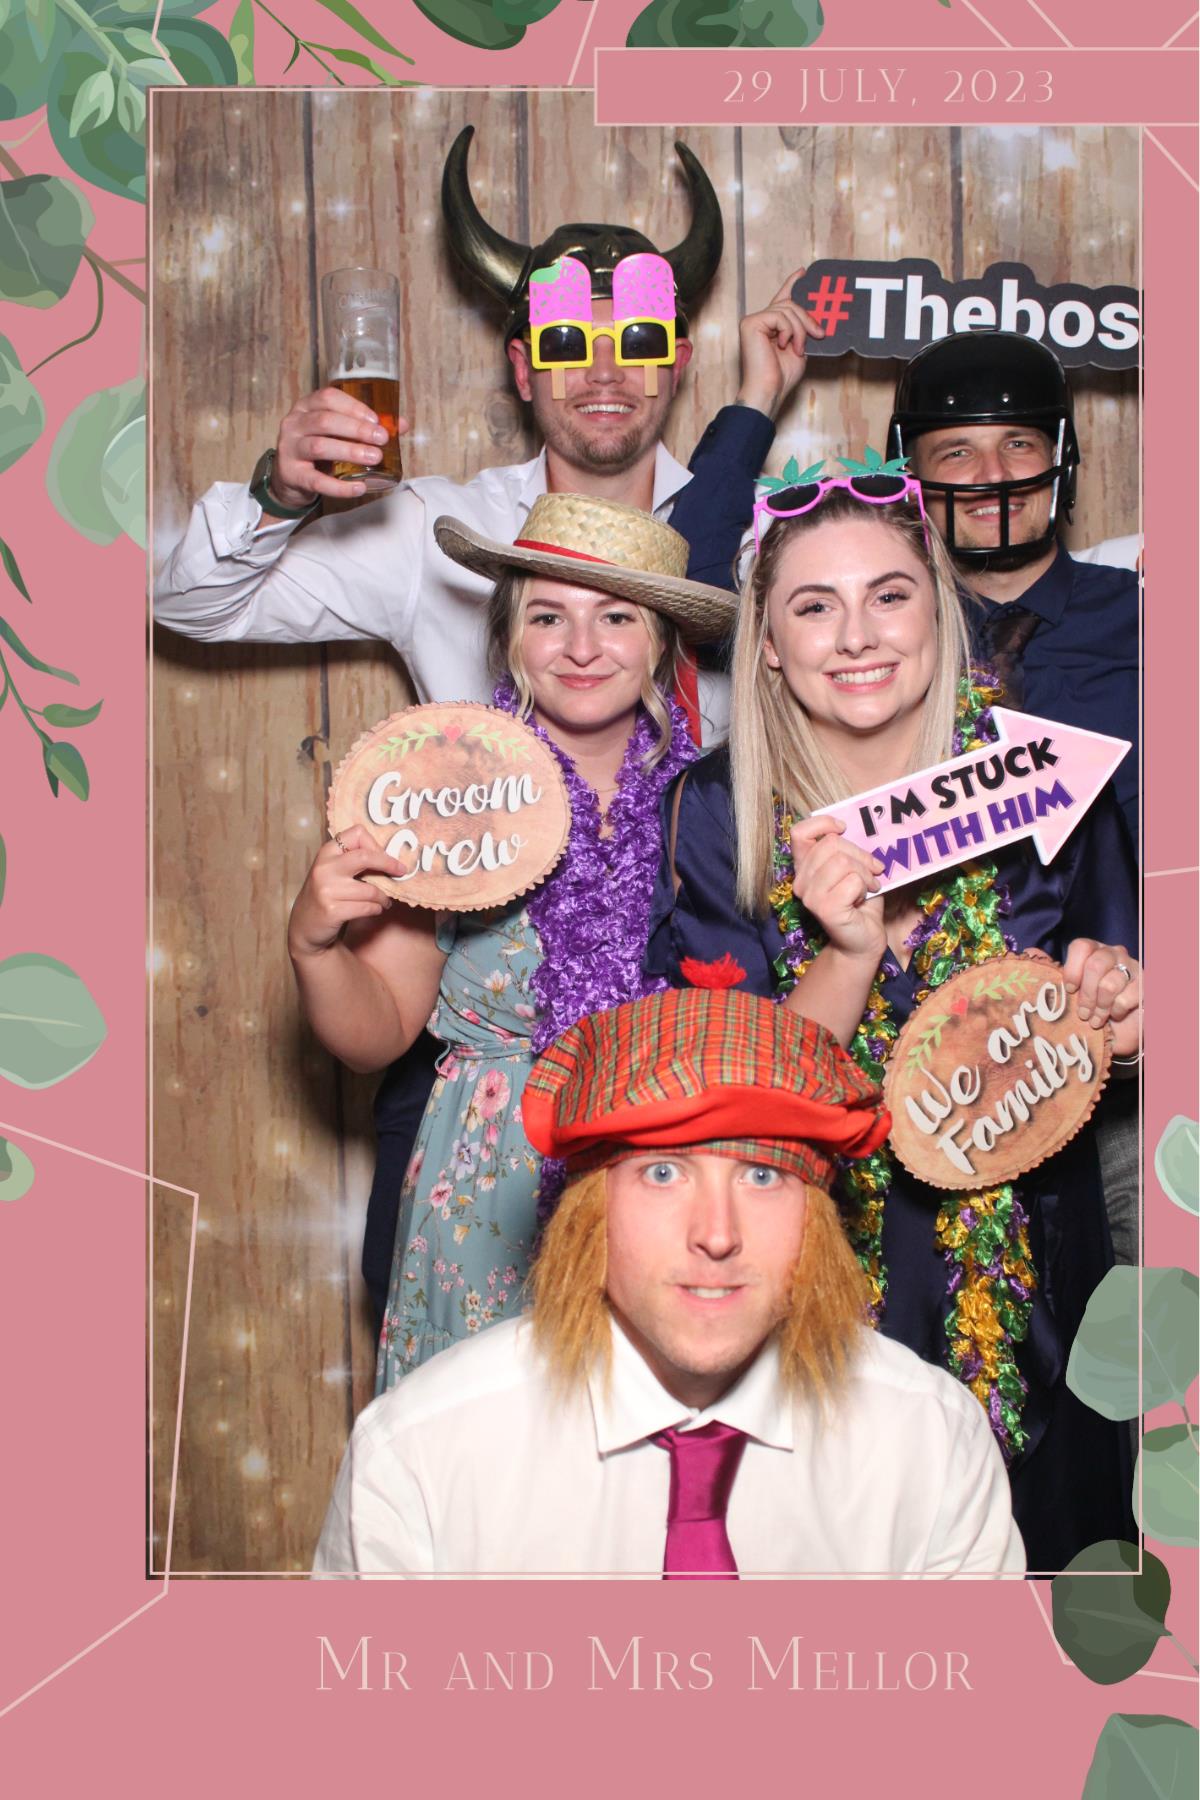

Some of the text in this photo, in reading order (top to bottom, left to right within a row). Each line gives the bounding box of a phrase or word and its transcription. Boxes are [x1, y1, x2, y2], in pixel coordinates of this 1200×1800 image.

[807, 275, 1144, 350] #Thebos
[367, 770, 542, 826] Groom
[859, 737, 1061, 838] I'M STUCK
[871, 779, 1076, 880] WITH HIM
[385, 829, 528, 882] Crew
[904, 980, 1067, 1135] We are
[936, 1033, 1094, 1176] Family
